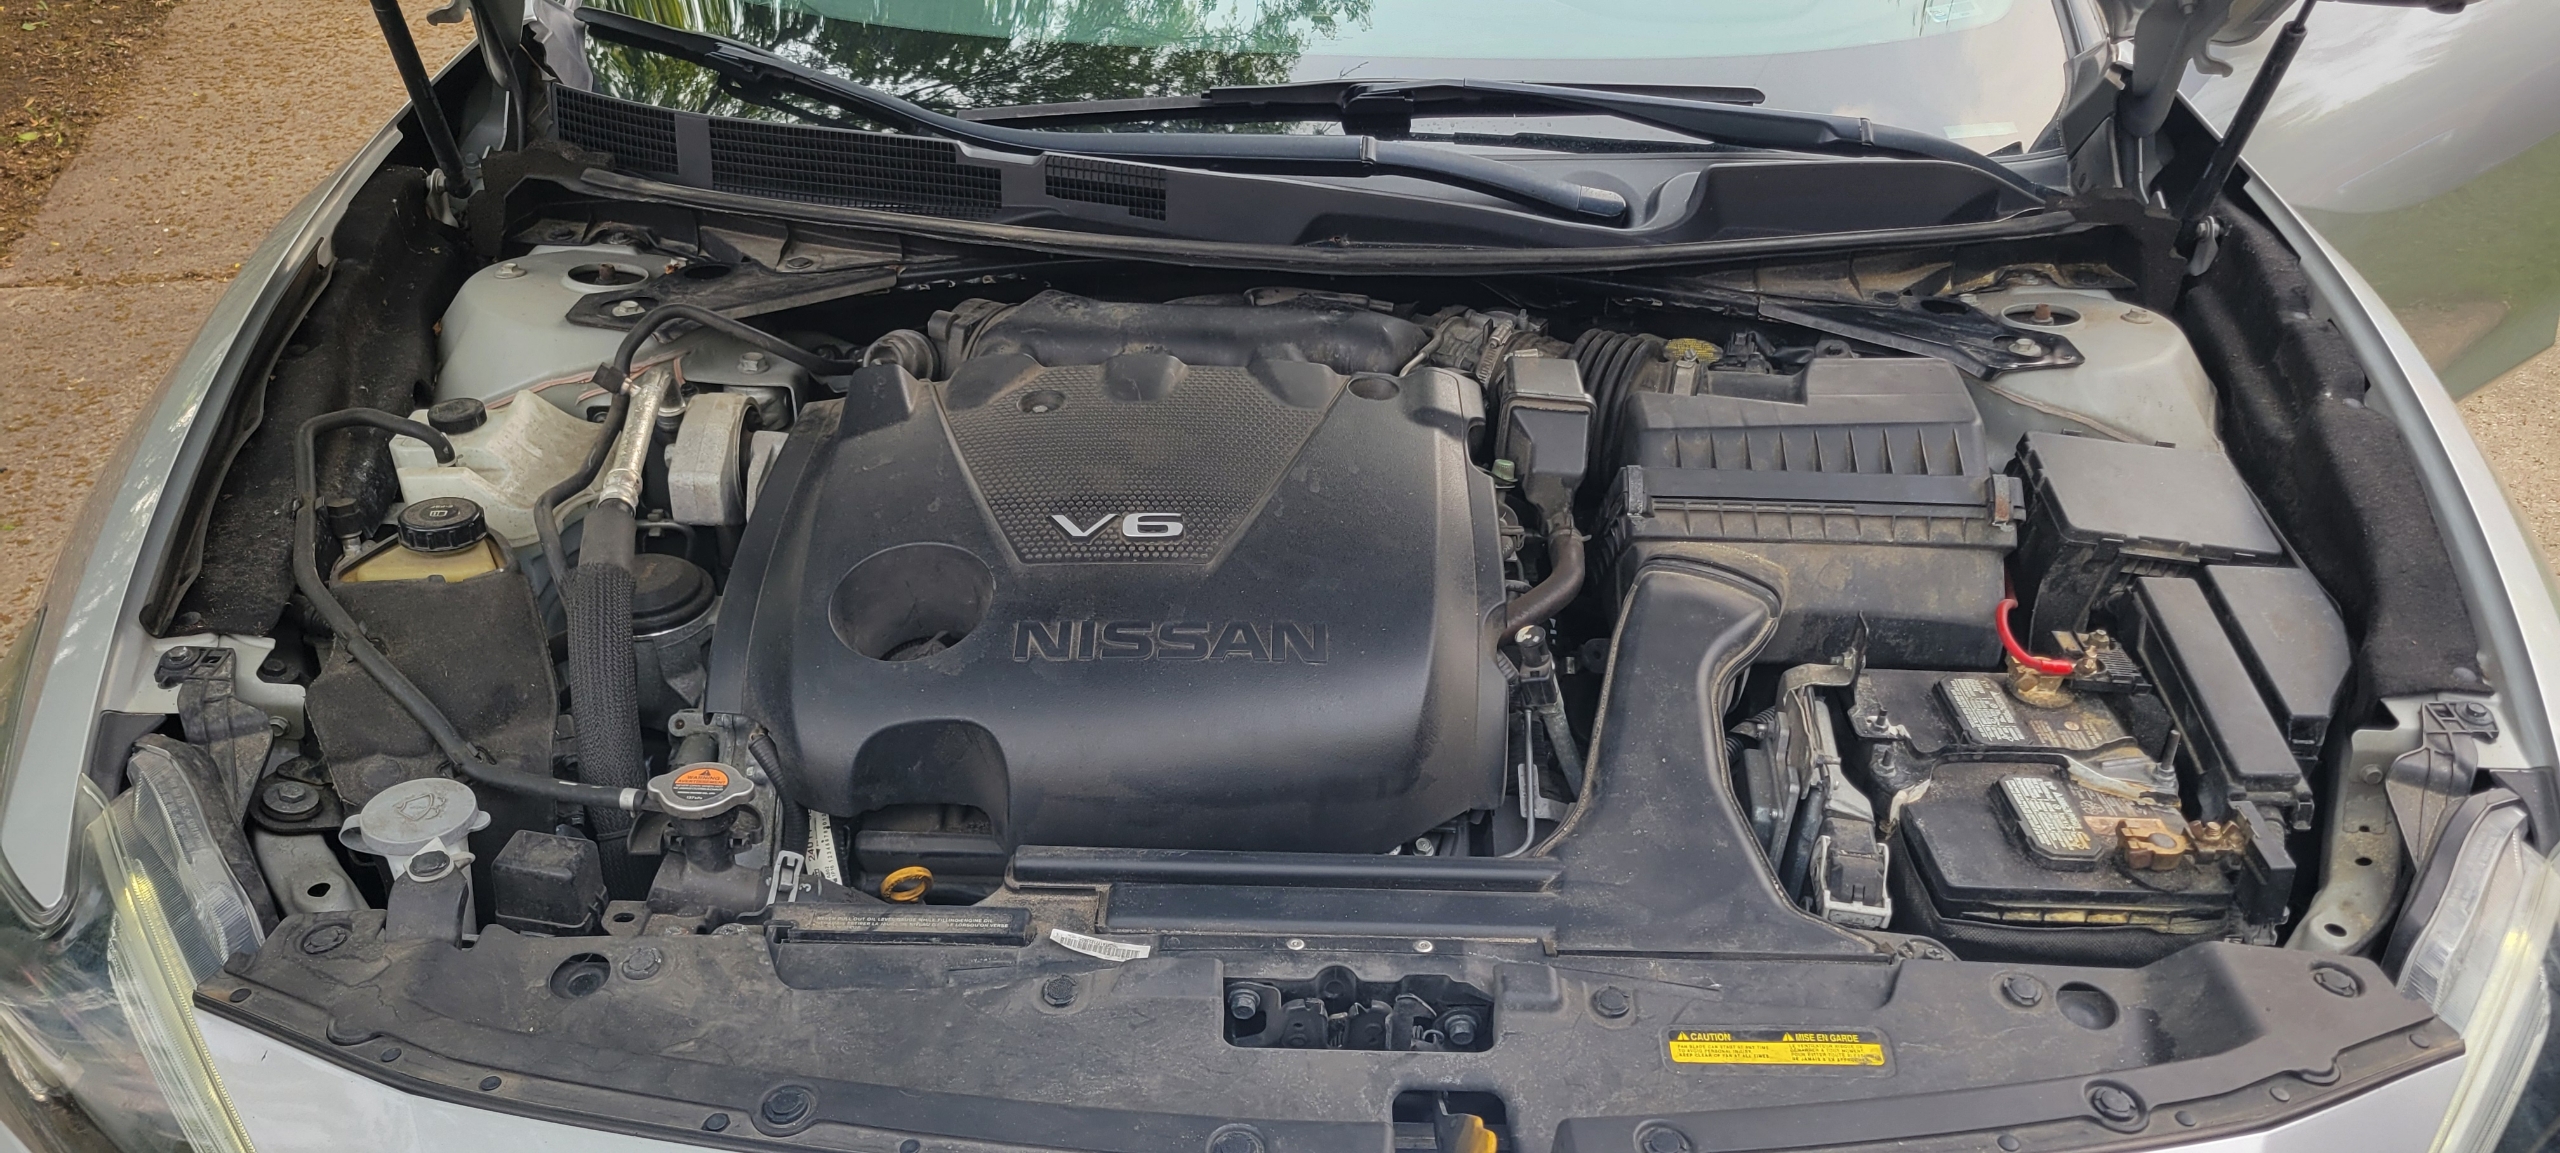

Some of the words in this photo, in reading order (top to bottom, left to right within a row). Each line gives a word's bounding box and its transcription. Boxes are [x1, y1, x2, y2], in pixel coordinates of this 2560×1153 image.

[1050, 512, 1184, 538] V6
[1013, 620, 1329, 665] NISSAN
[1690, 1032, 1731, 1041] CAUTION
[1795, 1033, 1815, 1041] MISE
[1830, 1034, 1859, 1042] GARDE
